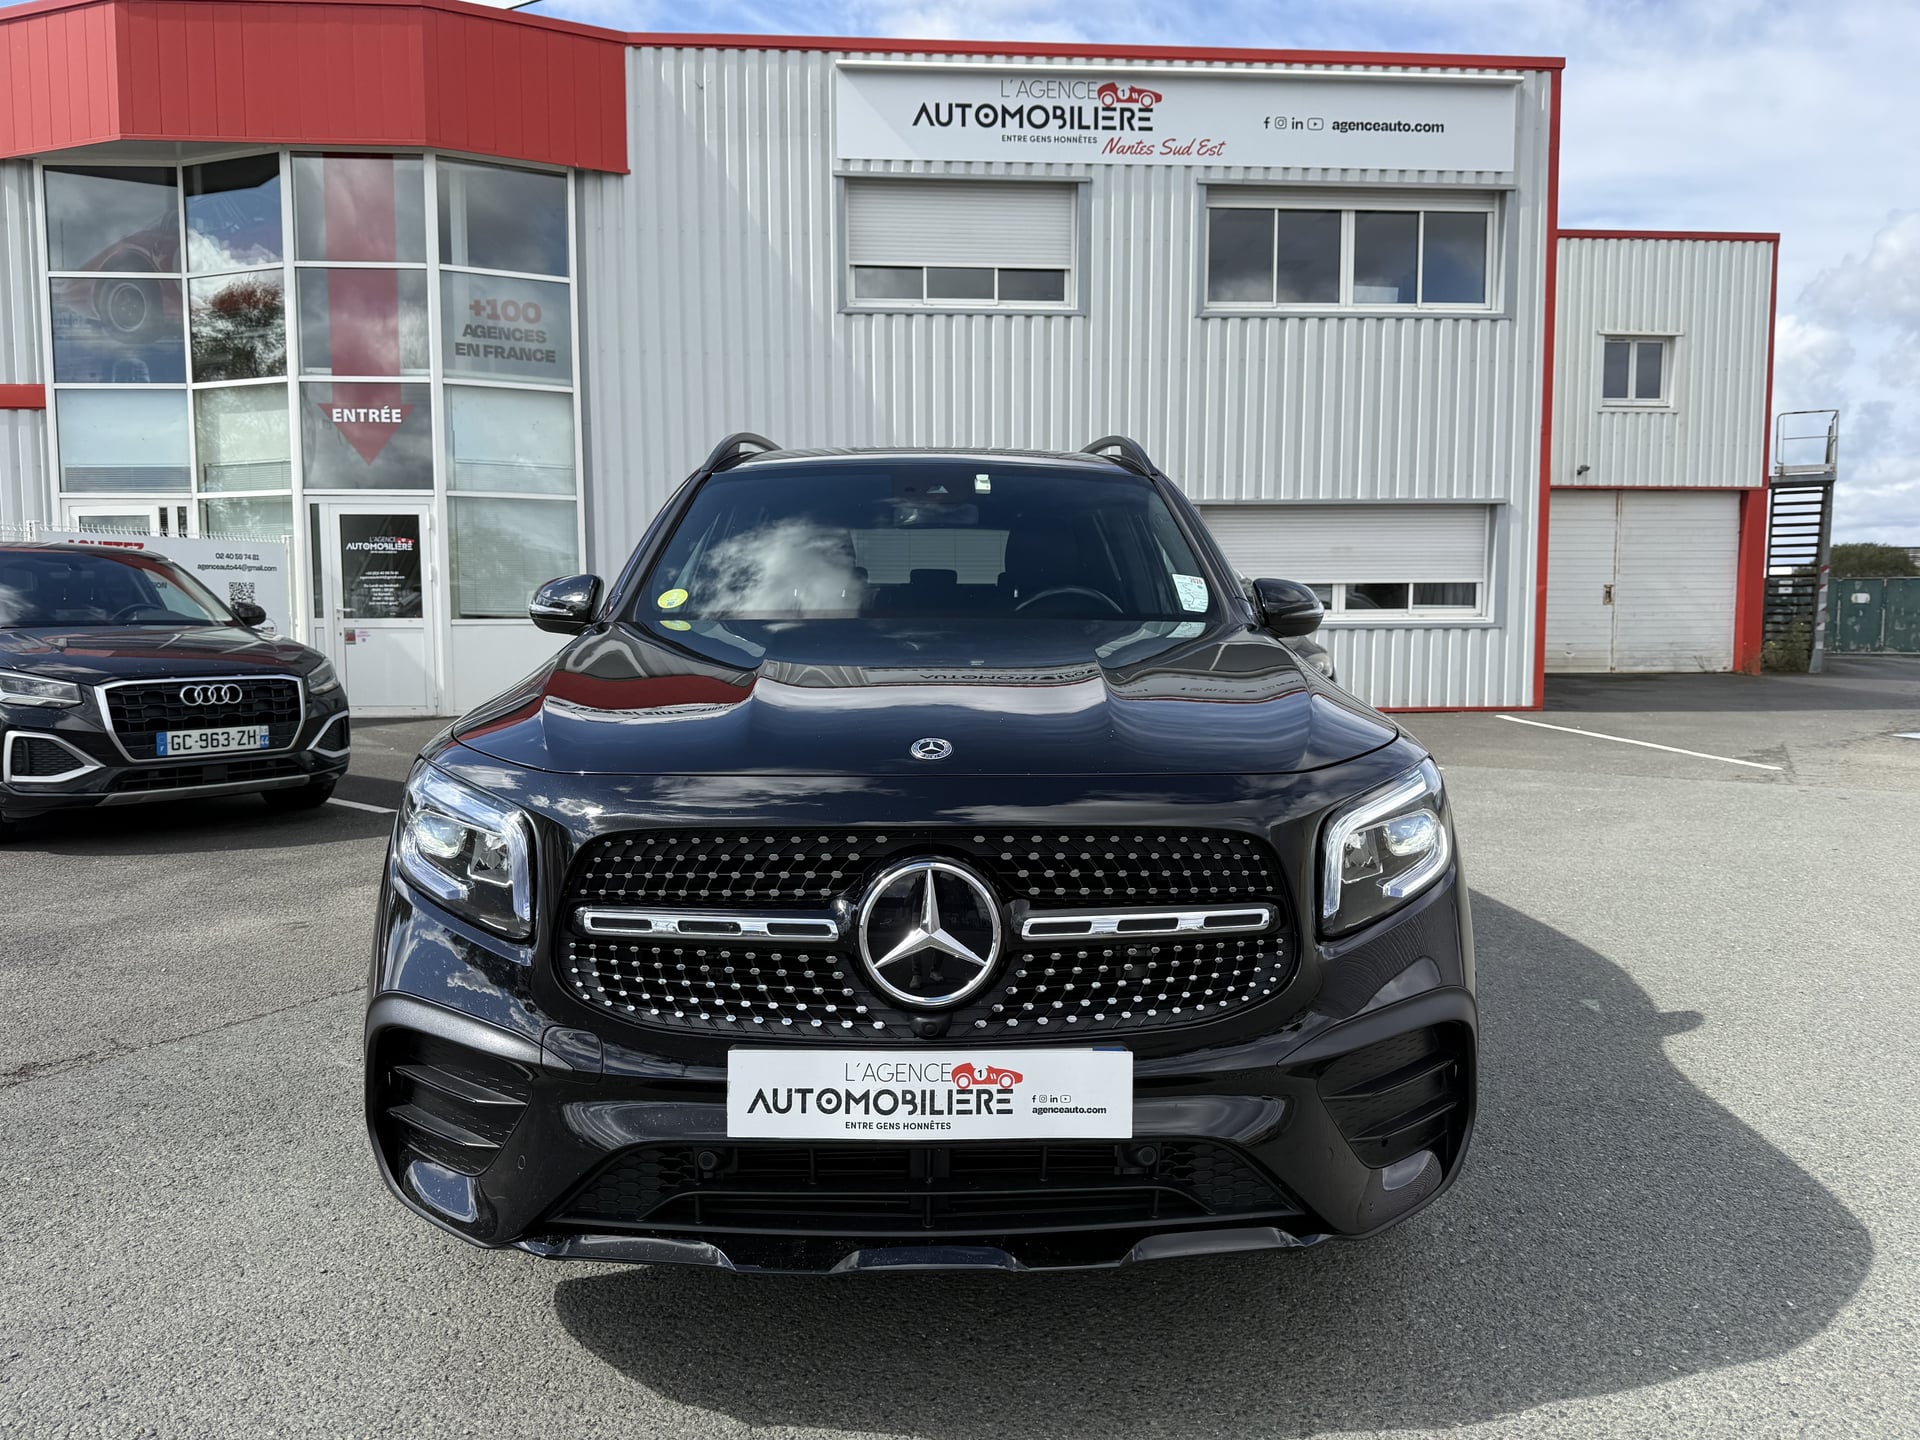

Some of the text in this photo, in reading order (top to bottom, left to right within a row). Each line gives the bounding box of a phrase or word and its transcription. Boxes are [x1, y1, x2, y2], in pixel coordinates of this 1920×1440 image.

[1001, 79, 1097, 100] L'AGENCE
[1331, 120, 1445, 133] agenceauto.com
[1001, 134, 1098, 145] ENTRE GENS HONNÊTES
[1101, 136, 1227, 157] Nantes Sud Est
[468, 298, 543, 324] +100
[462, 324, 547, 344] AGENCES
[454, 341, 556, 364] EN FRANCE
[331, 405, 402, 424] ENTRÉE
[171, 729, 256, 751] GC-963-ZH
[844, 1062, 952, 1083] L'AGENCE
[1032, 1105, 1107, 1115] agenceauto.com
[844, 1118, 952, 1130] ENTRE GENS HONNÊTES
